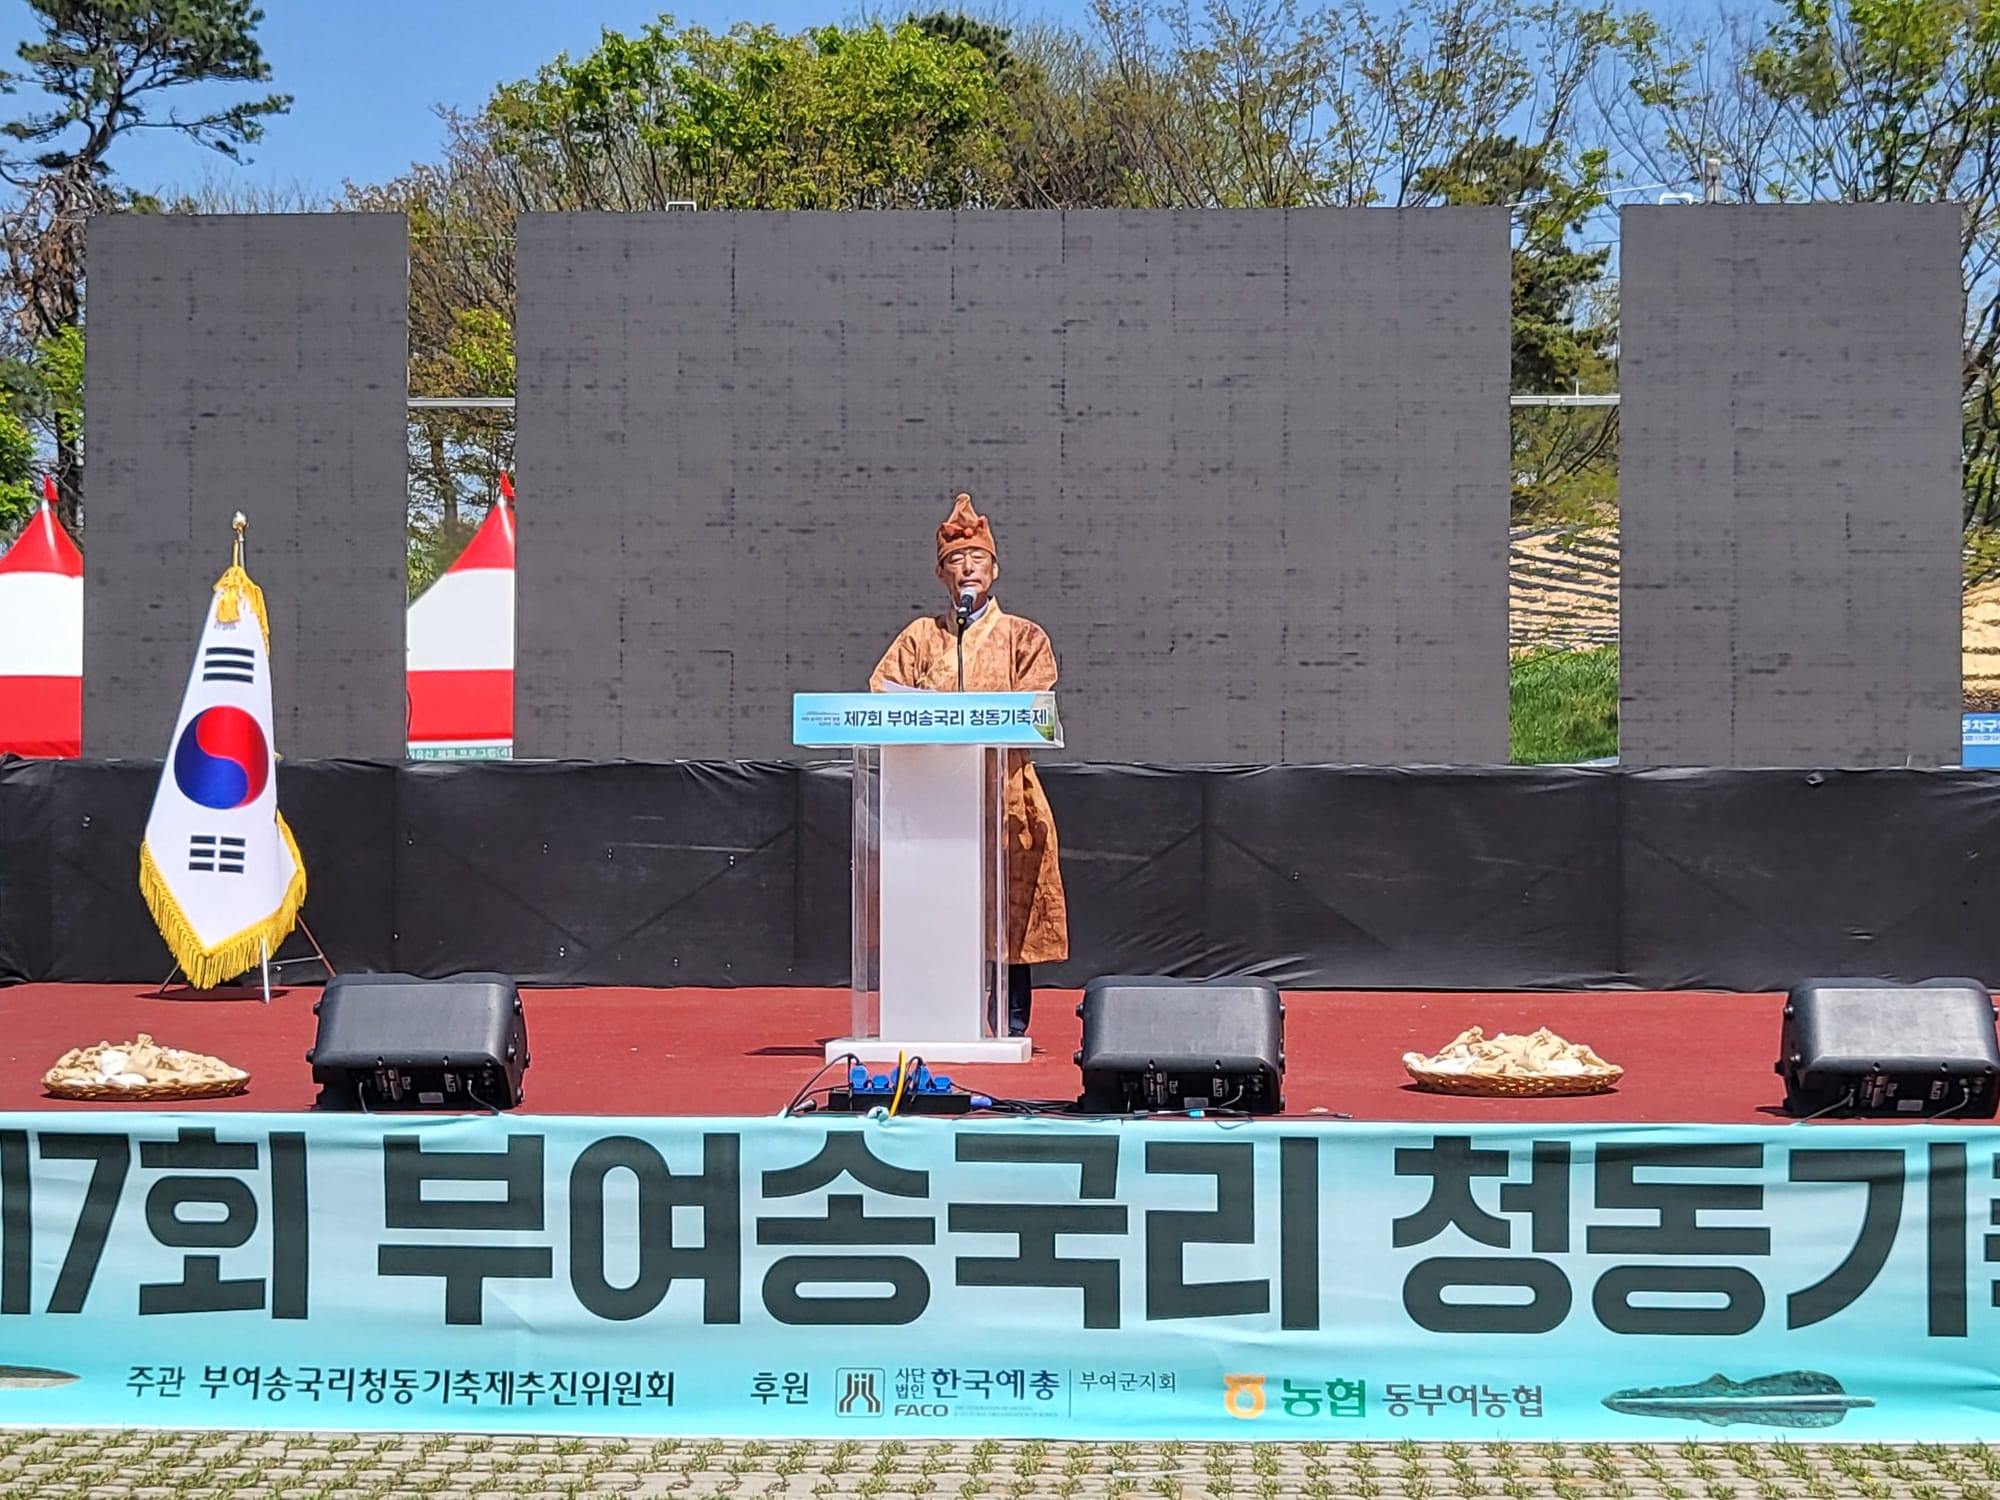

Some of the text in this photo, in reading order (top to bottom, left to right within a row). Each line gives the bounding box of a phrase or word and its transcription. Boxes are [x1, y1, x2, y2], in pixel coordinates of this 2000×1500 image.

[844, 708, 1048, 727] 제7회 부여송국리 청동기축제
[0, 1127, 2000, 1338] 7회 부여송국리 청동기
[126, 1363, 675, 1407] 주관 부여송국리청동기축제추진위원회
[750, 1371, 809, 1406] 후원
[895, 1367, 926, 1383] 사단
[895, 1383, 925, 1400] 법인
[930, 1367, 1061, 1401] 한국예총
[1078, 1370, 1177, 1394] 부여군지회
[894, 1403, 949, 1417] FACO
[1280, 1377, 1367, 1419] 농협
[1382, 1382, 1544, 1419] 동부여농협
